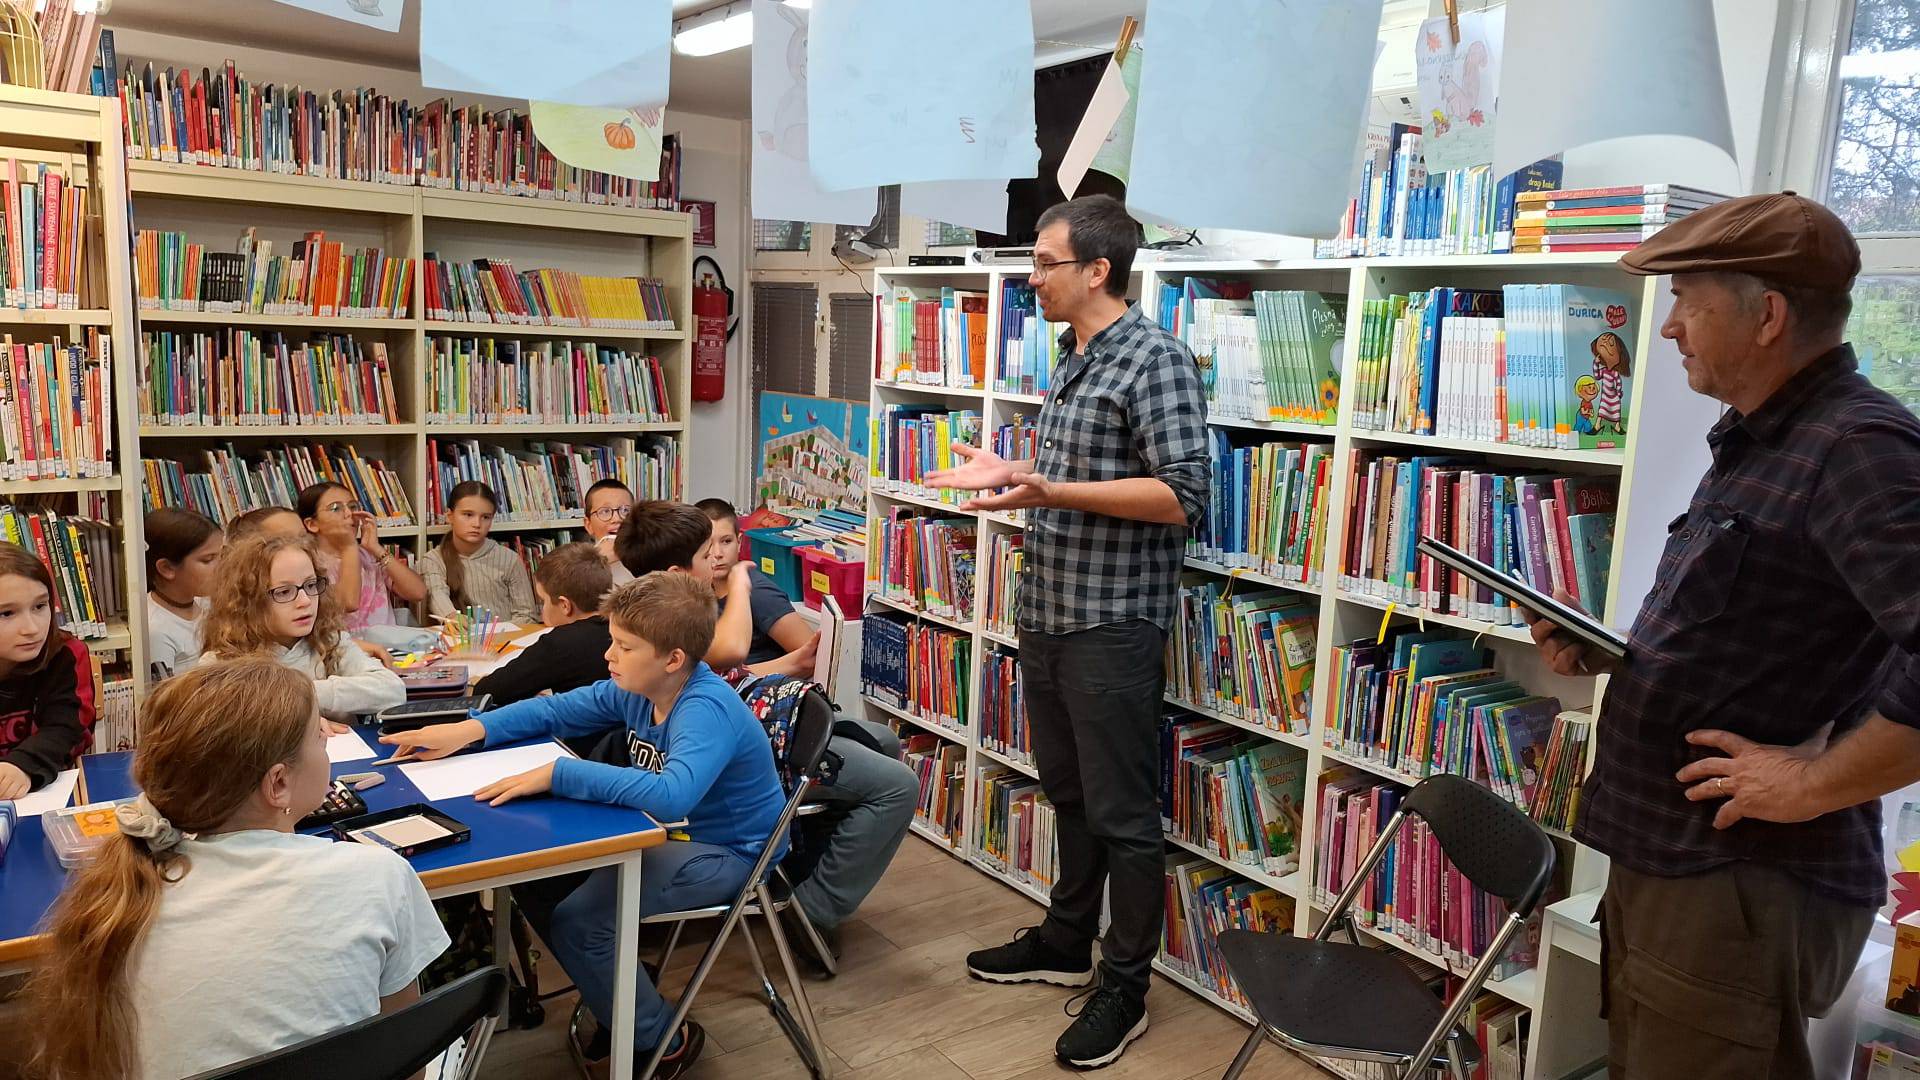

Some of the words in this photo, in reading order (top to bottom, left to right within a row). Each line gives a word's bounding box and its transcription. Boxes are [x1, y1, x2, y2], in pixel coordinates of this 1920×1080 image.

[48, 201, 57, 245] SUVREMENE
[46, 247, 56, 288] TEHNOLOG
[1567, 307, 1604, 320] DURICA
